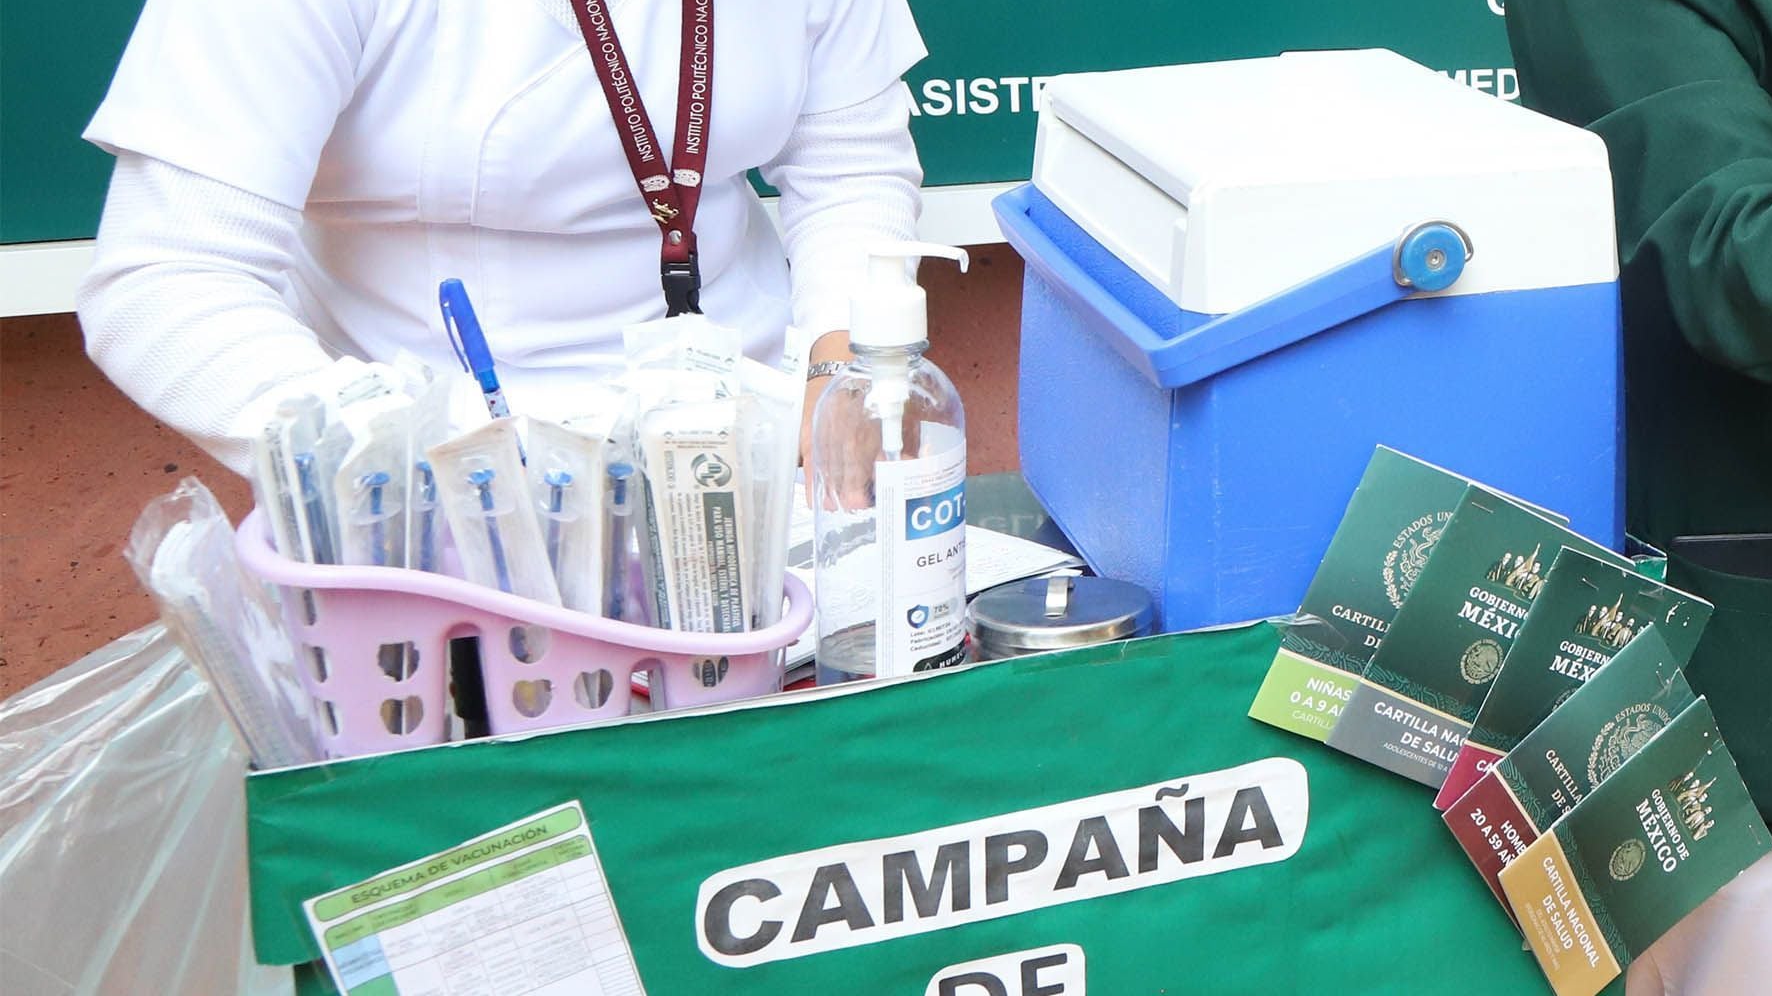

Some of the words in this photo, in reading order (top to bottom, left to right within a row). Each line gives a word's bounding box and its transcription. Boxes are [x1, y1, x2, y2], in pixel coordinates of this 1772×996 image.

[602, 42, 636, 114] POLITÉCNICO
[690, 24, 708, 100] POLITÉCNICO
[628, 114, 655, 163] INSTITUTO
[686, 100, 705, 154] INSTITUTO
[911, 491, 966, 531] COT
[1393, 514, 1433, 549] ESTADOS
[916, 552, 943, 568] GEL
[1302, 696, 1314, 709] A
[1316, 699, 1327, 713] 9
[1328, 704, 1345, 717] A
[1307, 677, 1353, 702] NIÑAS
[1615, 702, 1652, 723] ESTADOS
[1374, 701, 1438, 737] CARTILLA
[1400, 731, 1422, 749] DE
[1545, 749, 1584, 805] CARTILLA
[1552, 789, 1566, 809] DE
[1470, 808, 1485, 827] 20
[1480, 825, 1492, 839] A
[1488, 833, 1504, 851] 59
[1635, 798, 1677, 873] MÉXICO
[1651, 788, 1681, 844] GOBIERNO
[1676, 842, 1690, 861] DE
[351, 871, 425, 904] ESQUEMA
[427, 864, 450, 877] DE
[452, 824, 548, 867] VACUNACIÓN
[703, 782, 1284, 956] CAMPAÑA
[1542, 894, 1556, 914] DE
[1550, 912, 1574, 950] SALUD
[1543, 856, 1572, 910] CARTILLA
[1566, 908, 1600, 968] NACIONAL
